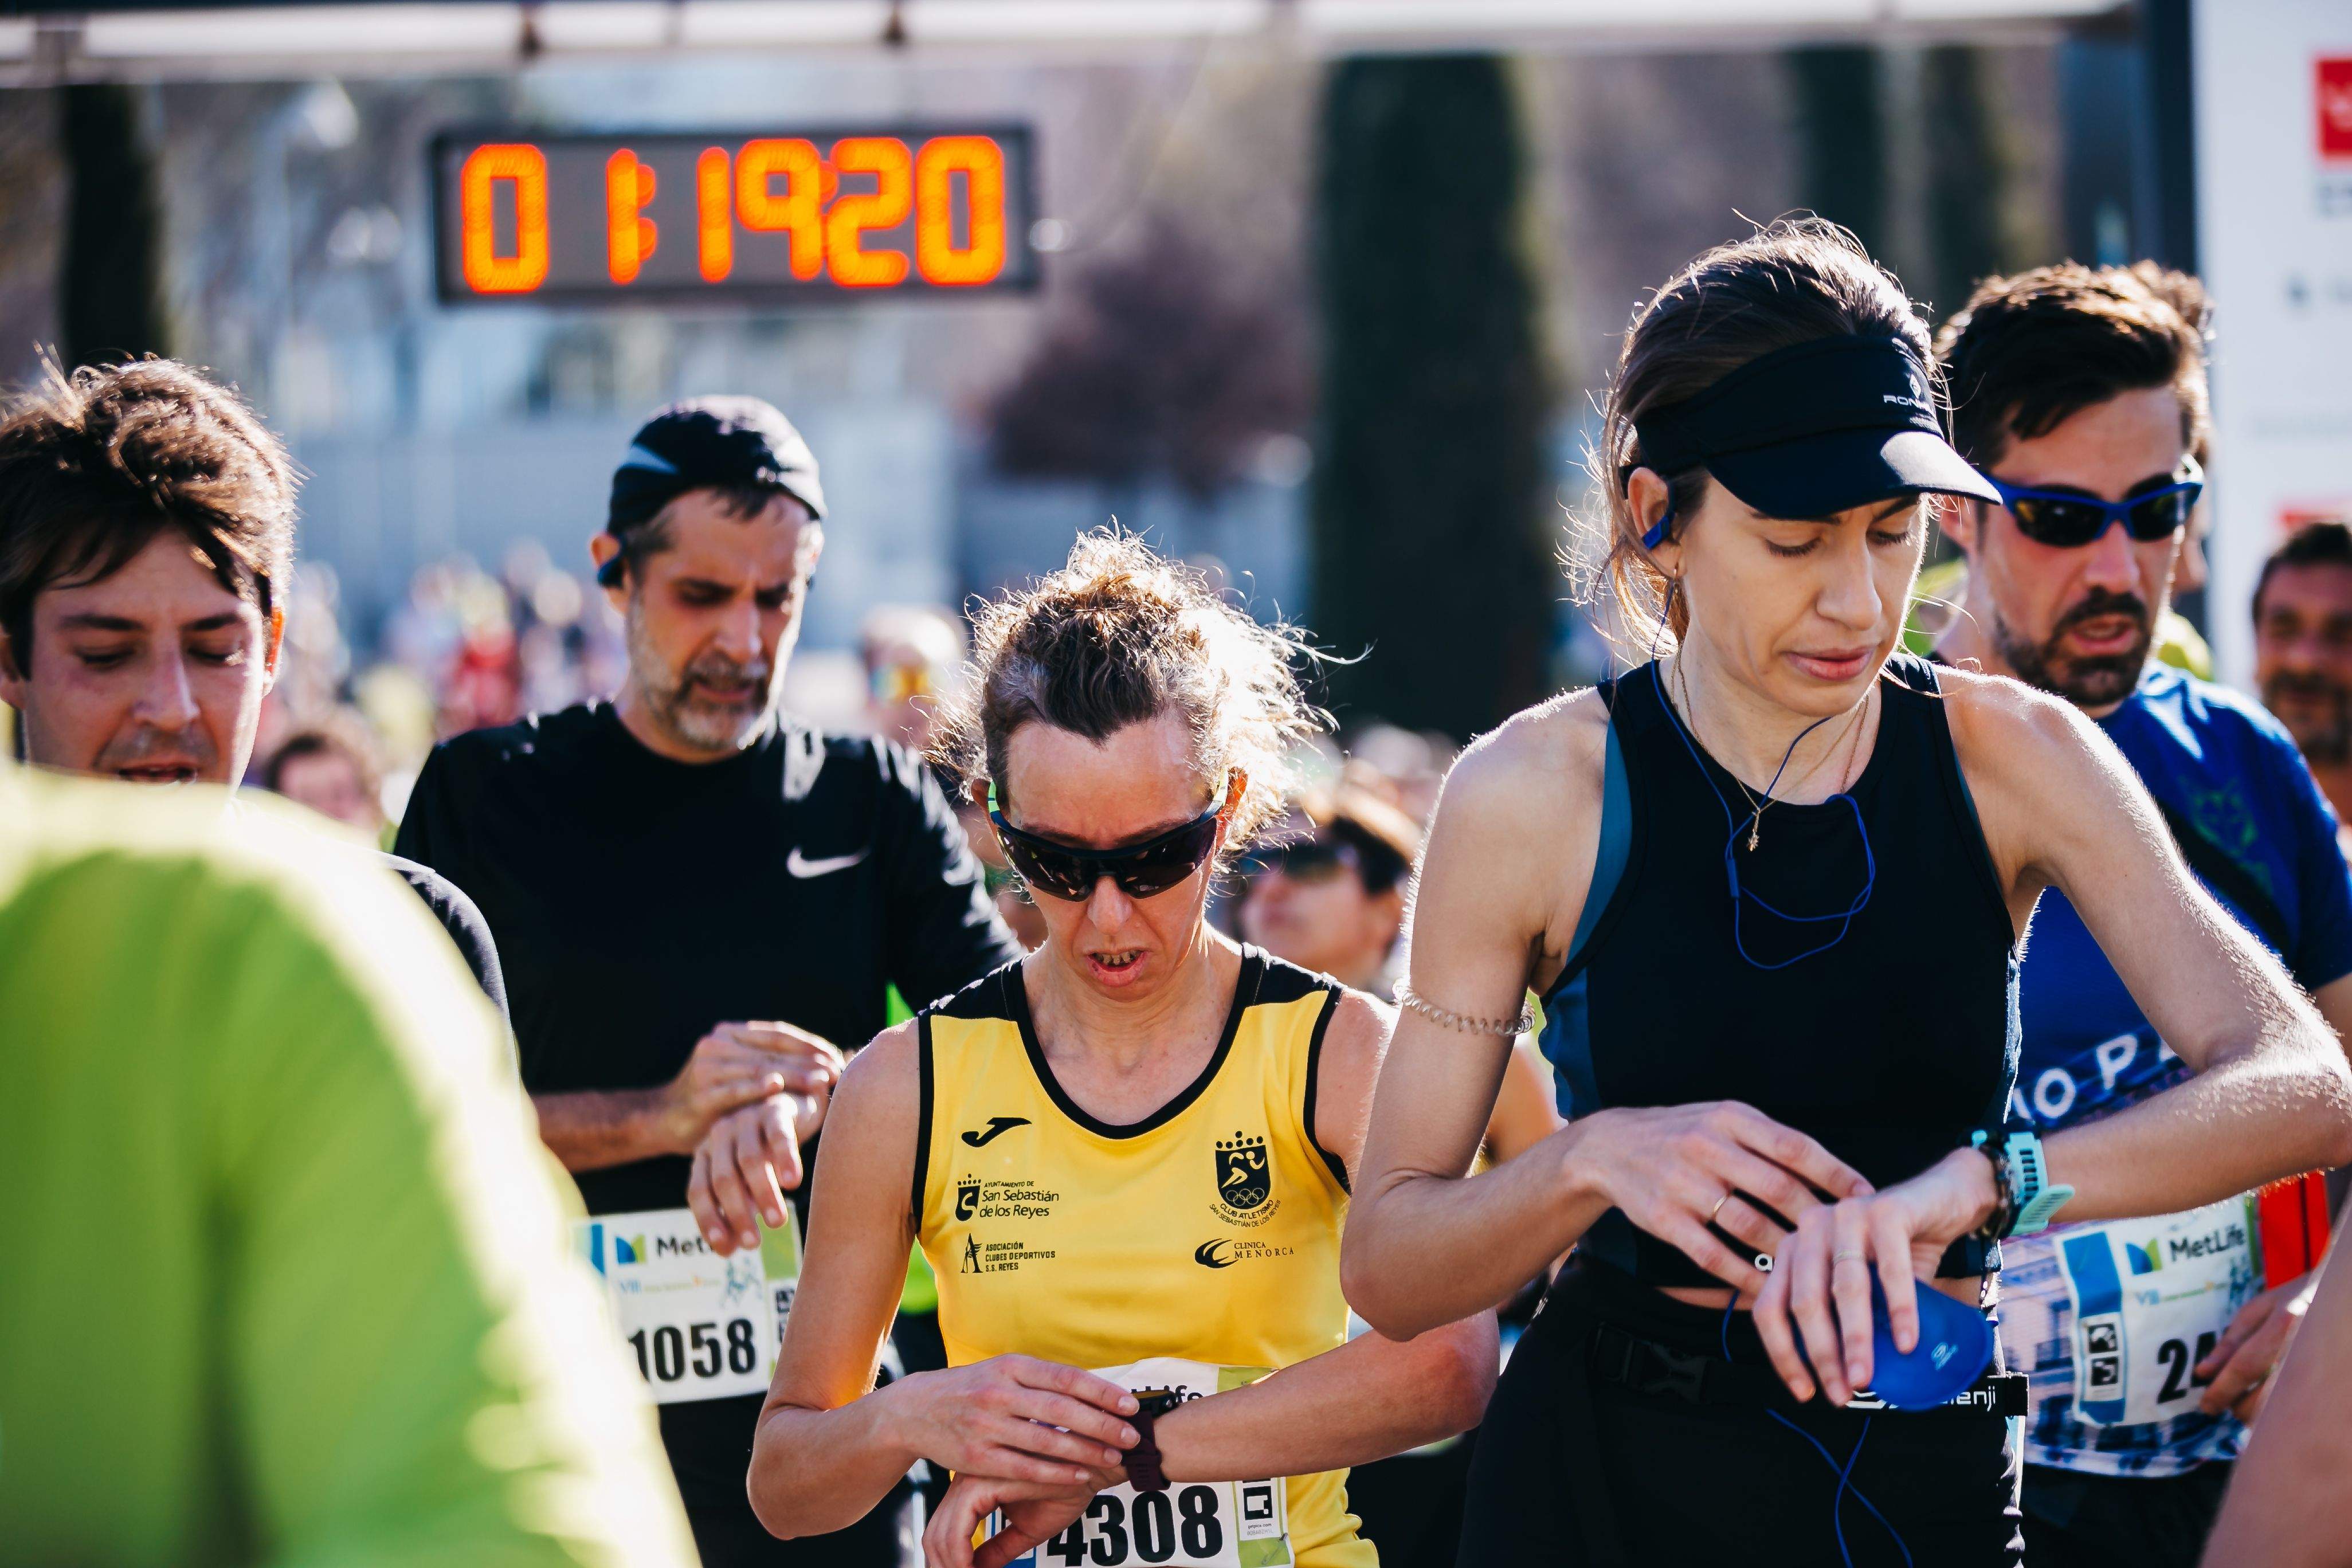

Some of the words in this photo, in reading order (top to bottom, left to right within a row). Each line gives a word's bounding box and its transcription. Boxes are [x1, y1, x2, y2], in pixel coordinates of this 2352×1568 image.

[982, 1190, 1000, 1202] San
[1003, 1189, 1059, 1202] Sebastián
[980, 1205, 993, 1217] de
[995, 1204, 1010, 1216] los
[1013, 1205, 1049, 1219] Reyes
[1210, 1204, 1220, 1215] SAN
[1260, 1216, 1270, 1225] LOS
[1269, 1199, 1281, 1217] REYES
[1220, 1204, 1237, 1217] CLUB
[1238, 1199, 1273, 1219] ATLETISMO
[986, 1241, 1024, 1252] ASOCIACIÓN
[1234, 1247, 1294, 1259] MENORCA
[986, 1253, 1007, 1262] CLUBES
[1009, 1251, 1056, 1260] DEPORTIVOS
[999, 1263, 1018, 1271] REYES
[628, 1318, 756, 1382] 1058
[1047, 1485, 1223, 1567] 4308
